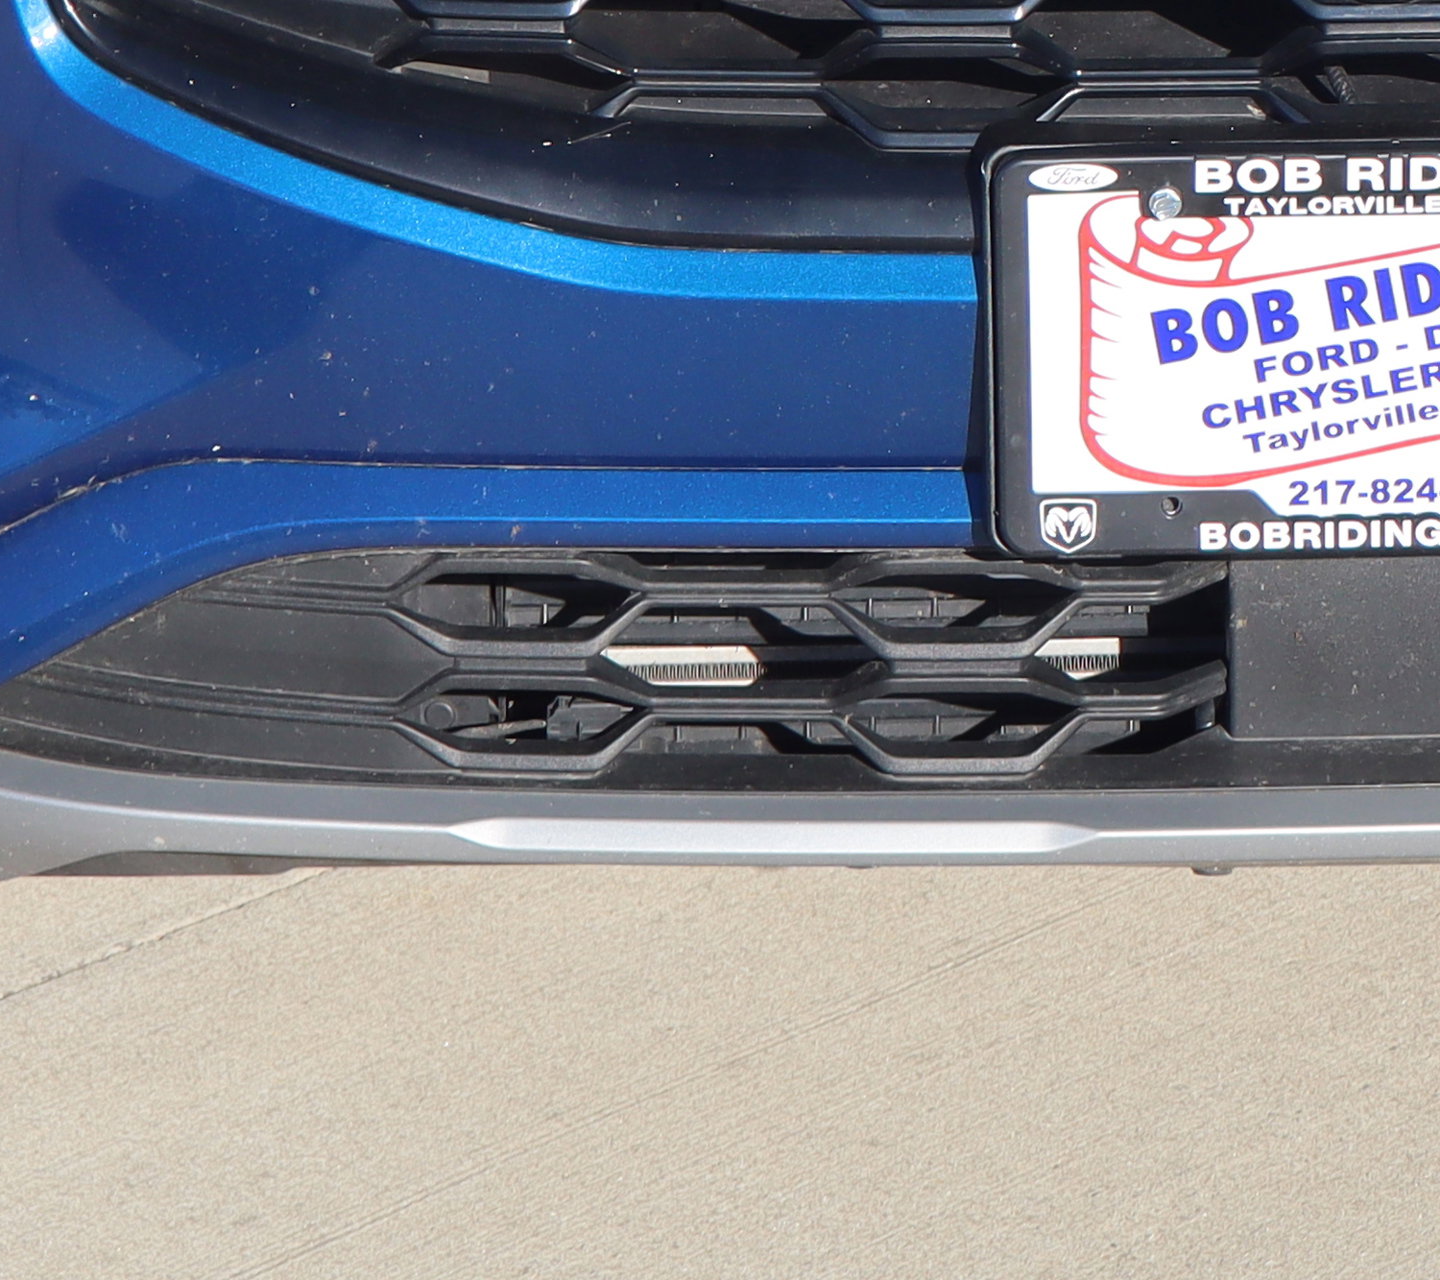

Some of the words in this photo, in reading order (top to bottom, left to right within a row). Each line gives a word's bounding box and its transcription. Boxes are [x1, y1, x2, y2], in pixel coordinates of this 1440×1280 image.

[1047, 166, 1099, 187] Ford
[1193, 157, 1322, 193] BOB
[1152, 288, 1300, 364] BOB
[1254, 338, 1380, 383] FORD
[1243, 402, 1440, 455] Taylorville
